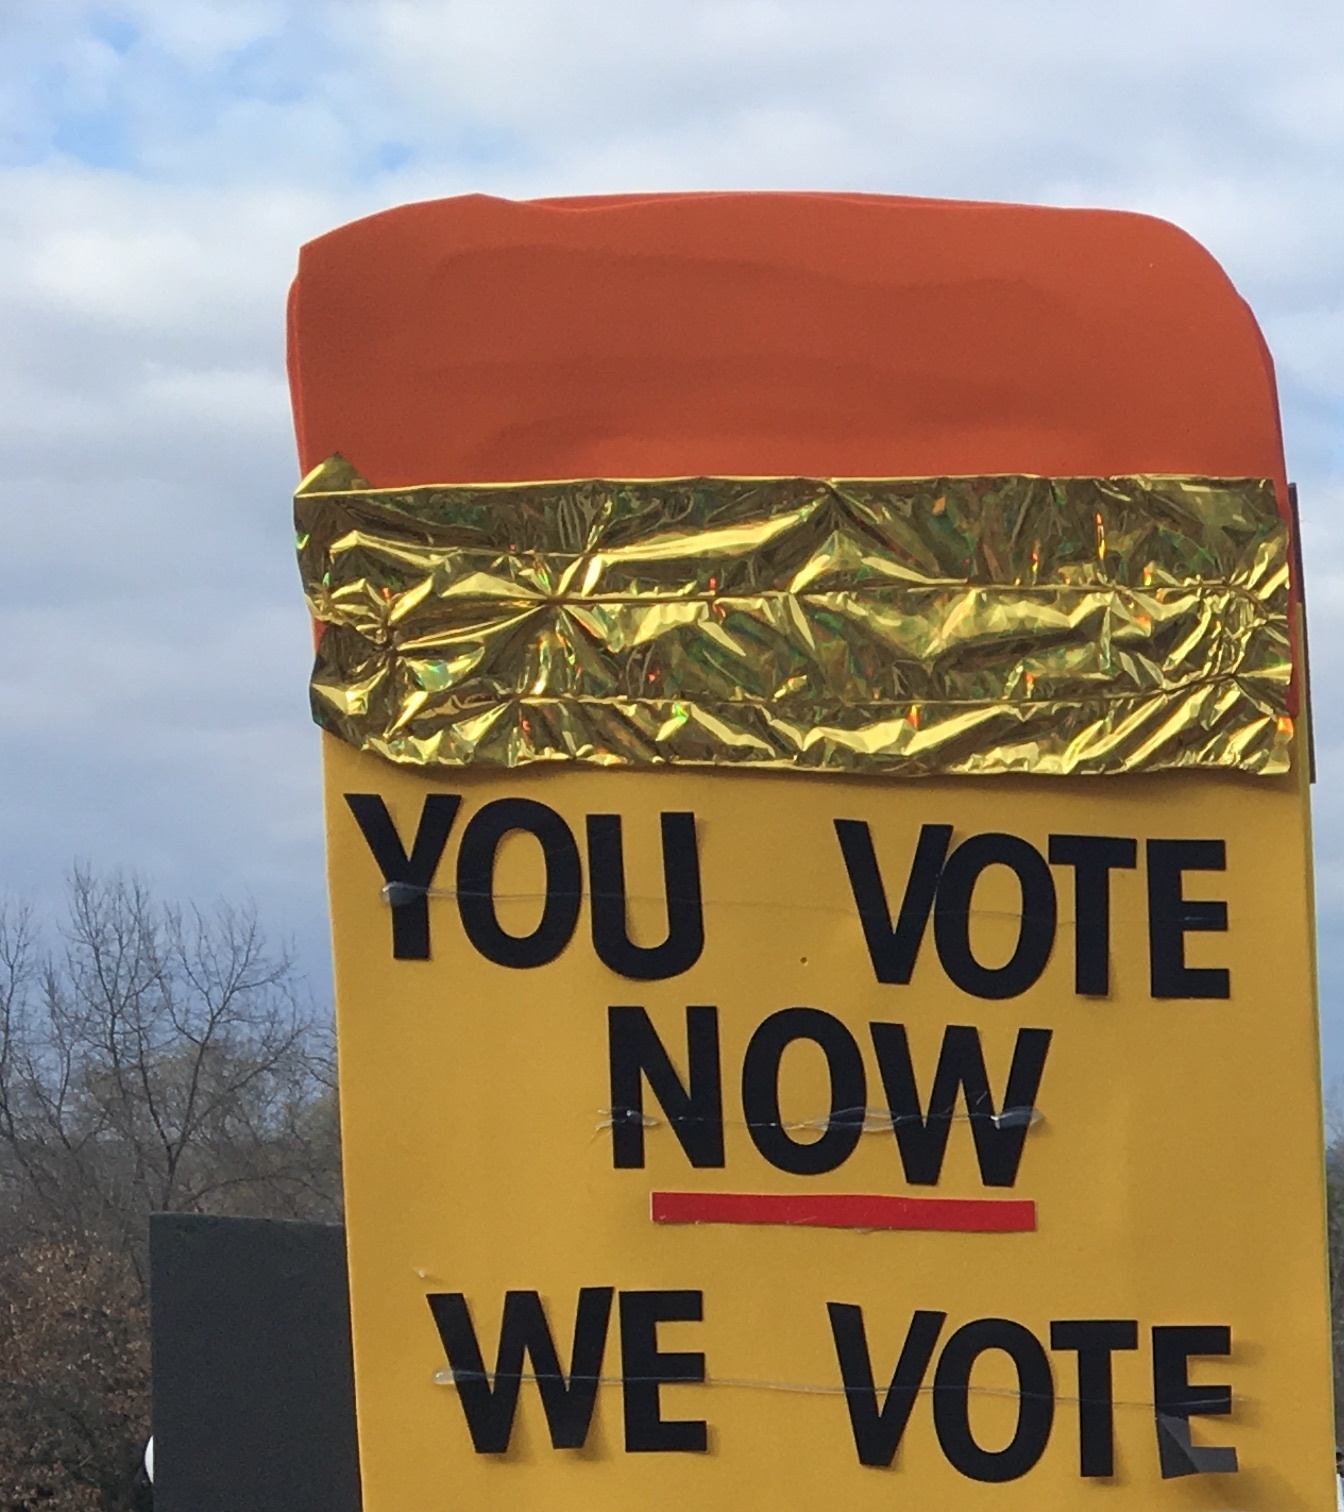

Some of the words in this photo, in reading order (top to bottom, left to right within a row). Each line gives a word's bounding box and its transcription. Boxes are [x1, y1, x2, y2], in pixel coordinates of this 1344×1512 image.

[343, 793, 705, 981] YOU
[833, 818, 1231, 1001] VOTE
[606, 1005, 1054, 1188] NOW
[426, 1286, 708, 1455] WE
[826, 1300, 1238, 1484] VOTE
